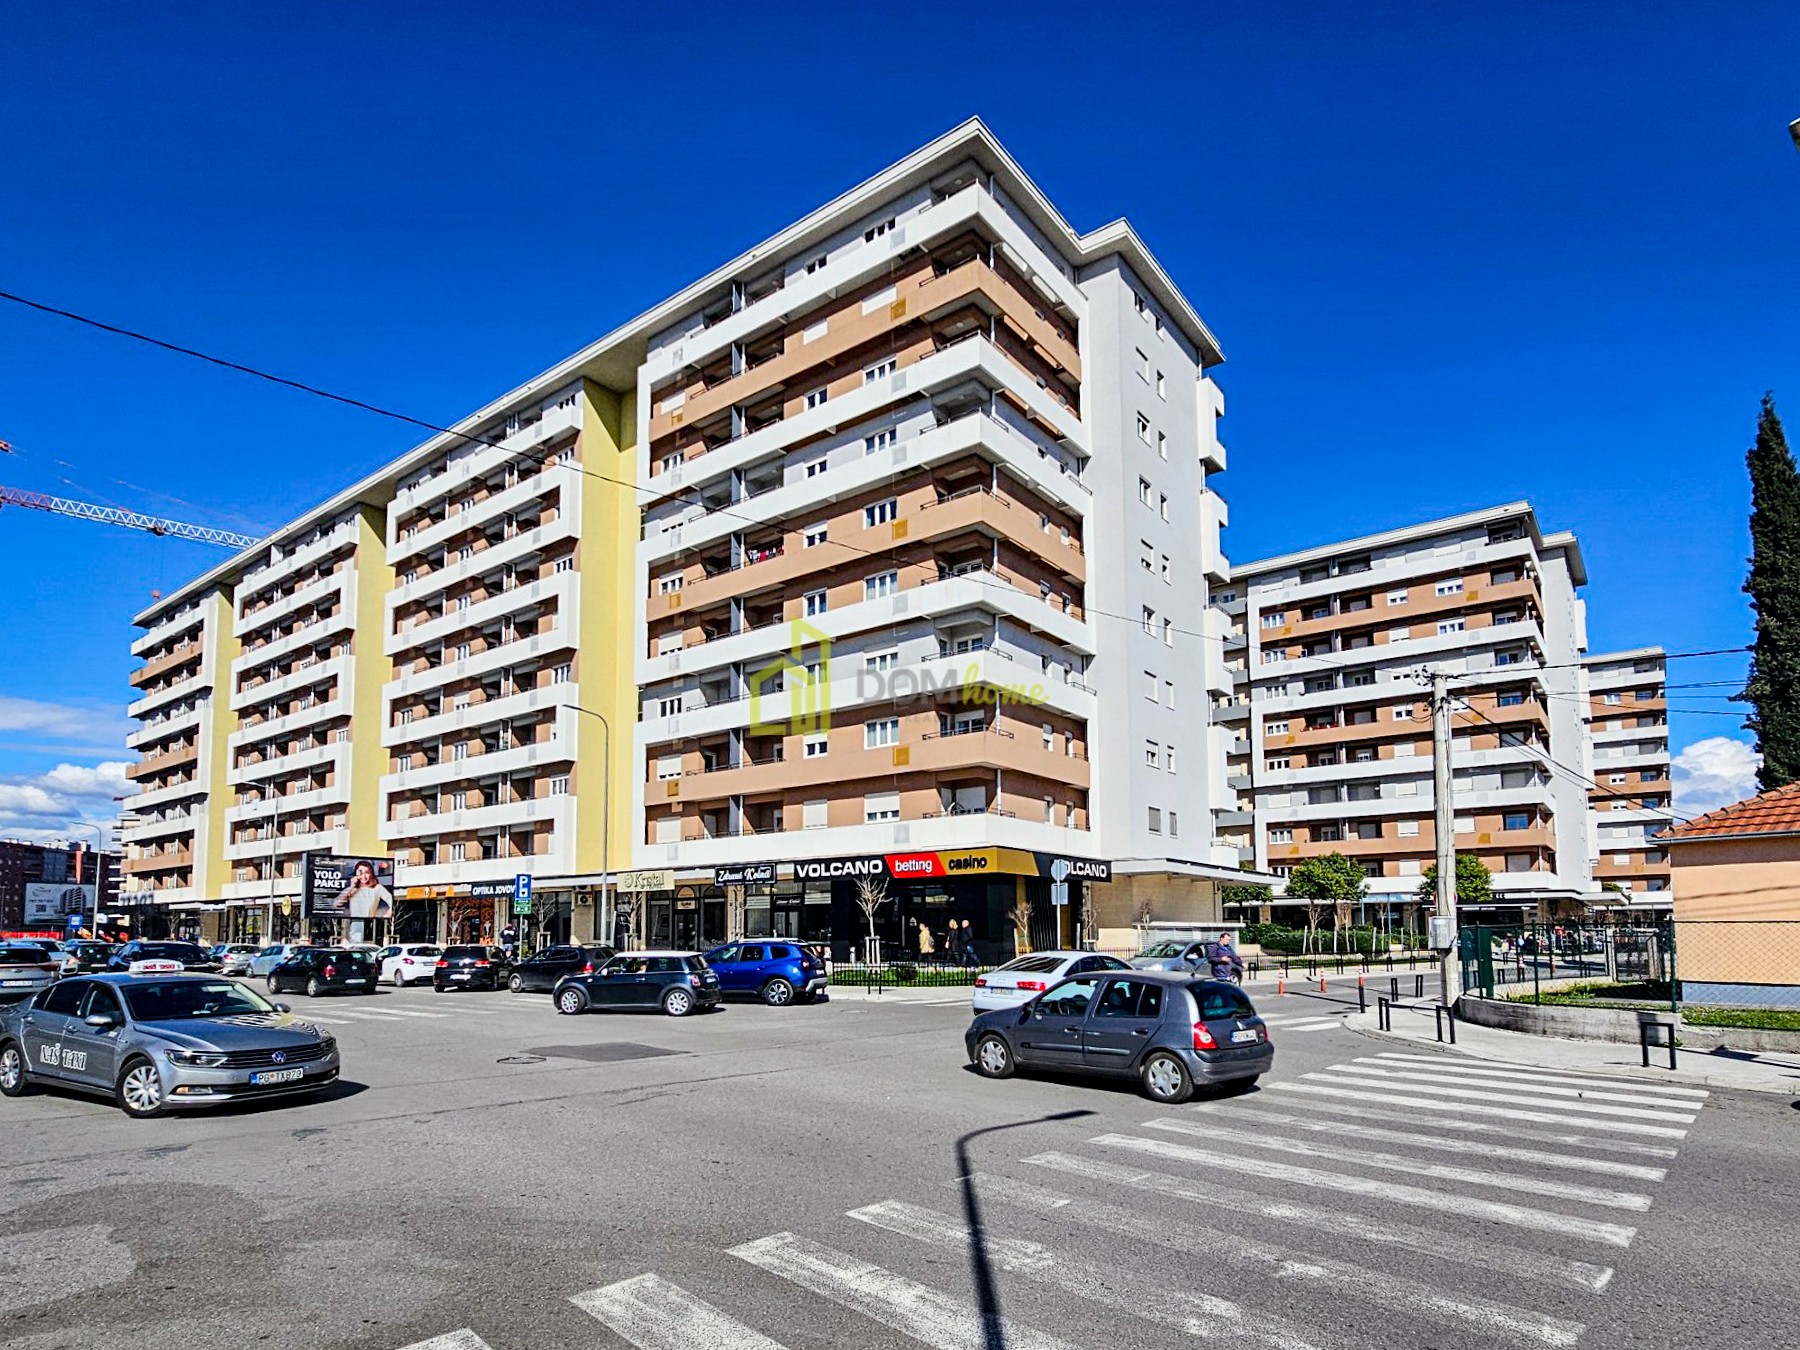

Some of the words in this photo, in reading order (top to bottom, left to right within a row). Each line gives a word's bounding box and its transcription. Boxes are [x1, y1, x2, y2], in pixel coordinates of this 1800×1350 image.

[796, 860, 882, 877] VOLCANO
[895, 859, 932, 873] betting
[949, 855, 987, 870] casino
[1064, 861, 1107, 878] OLCANO
[314, 870, 341, 879] YOLO
[314, 879, 347, 888] PAKET
[519, 876, 528, 888] P
[472, 886, 494, 896] OPTIKA
